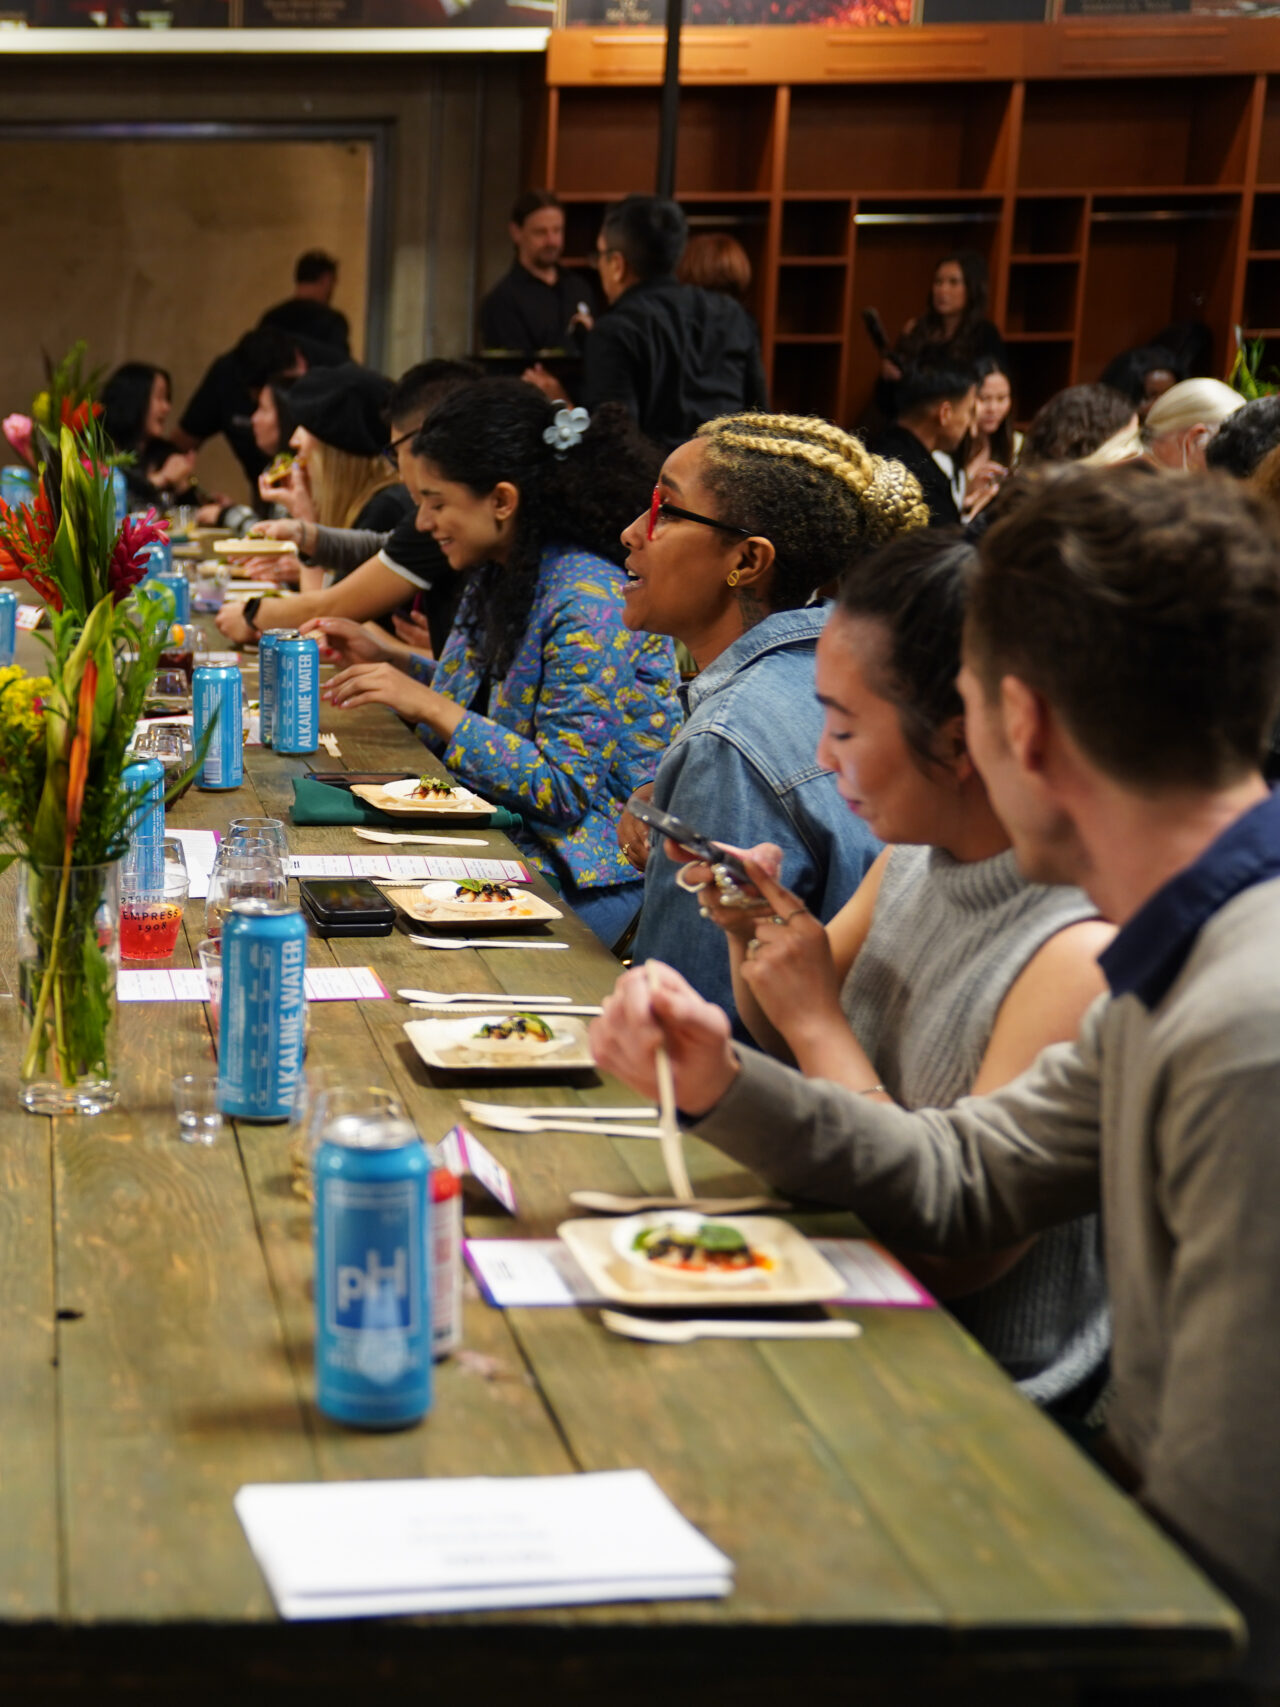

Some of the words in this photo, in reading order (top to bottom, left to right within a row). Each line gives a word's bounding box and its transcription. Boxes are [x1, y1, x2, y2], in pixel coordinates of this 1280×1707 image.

[263, 648, 273, 685] WATER
[298, 654, 313, 693] WATER
[298, 694, 313, 748] ALKALINE
[122, 908, 179, 921] EMPRESS
[137, 922, 167, 933] 1908
[281, 939, 303, 1010] WATER
[277, 1011, 303, 1107] ALKALINE
[337, 1246, 407, 1312] pH
